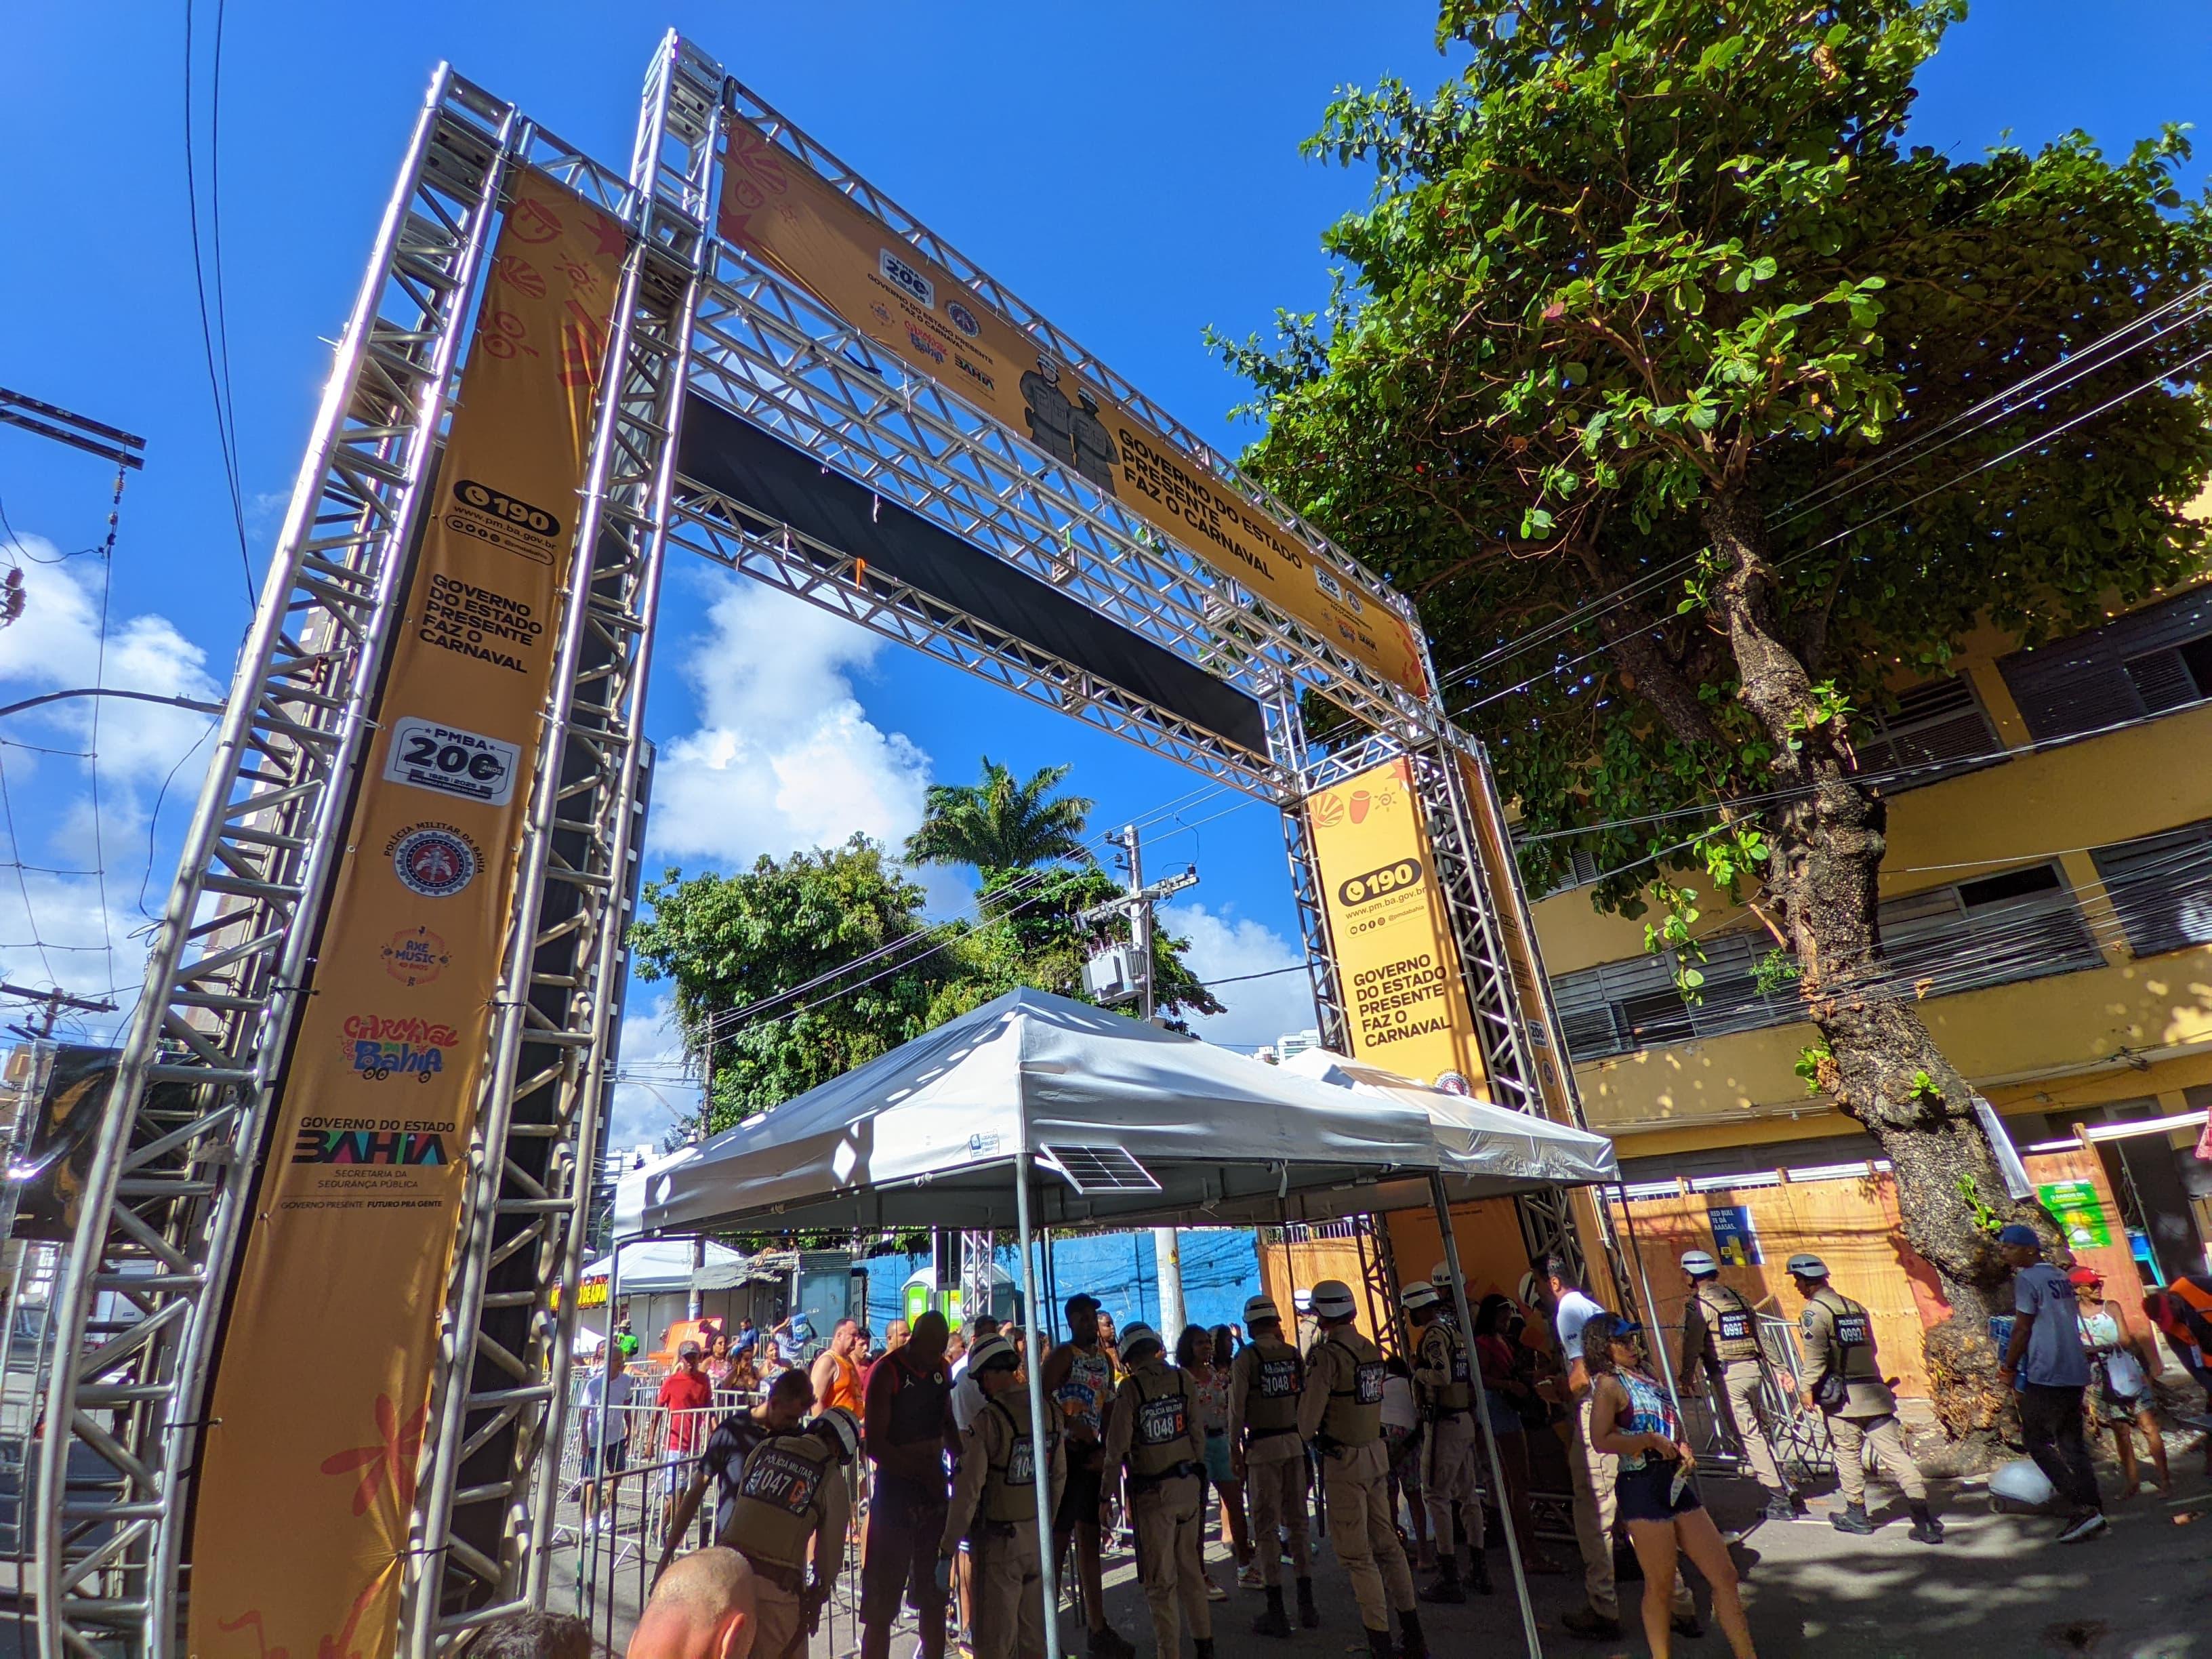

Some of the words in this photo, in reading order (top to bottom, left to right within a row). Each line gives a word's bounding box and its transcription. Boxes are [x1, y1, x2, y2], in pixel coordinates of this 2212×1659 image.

[867, 273, 908, 304] GOVERNO
[909, 302, 922, 314] DO
[923, 312, 954, 337] ESTADO
[955, 333, 994, 365] PRESENTE
[901, 303, 916, 318] FAZ
[925, 321, 966, 352] CARNAVAL
[1119, 428, 1210, 504] GOVERNO
[1214, 496, 1239, 524] DO
[1242, 515, 1302, 569] ESTADO
[1121, 445, 1221, 529] PRESENTE
[455, 506, 556, 549] www.pm.ba.gov.br
[493, 497, 550, 530] 190
[1124, 465, 1162, 504] FAZ
[1166, 495, 1180, 515] O
[1185, 508, 1275, 581] CARNAVAL
[430, 586, 460, 607] DO
[464, 599, 542, 634] ESTADO
[433, 573, 531, 617] GOVERNO
[423, 613, 463, 638] FAZ
[467, 630, 483, 643] O
[426, 600, 533, 647] PRESENTE
[419, 628, 527, 674] CARNAVAL
[434, 728, 488, 751] PMBA
[454, 779, 477, 788] 2025
[482, 765, 502, 774] ANOS
[384, 825, 414, 857] POLÍCIA
[416, 821, 460, 835] MILITAR
[462, 833, 474, 846] DA
[473, 846, 485, 874] BAHIA
[1366, 863, 1413, 895] 190
[1345, 886, 1427, 920] www.pm.ba.gov.br
[1388, 905, 1425, 922] @pmdabahia
[395, 949, 436, 964] MUSIC
[1353, 954, 1431, 986] GOVERNO
[1356, 985, 1379, 1002] DO
[1382, 965, 1447, 995] ESTADO
[1359, 983, 1444, 1017] PRESENTE
[1362, 1013, 1393, 1033] FAZ
[1395, 1010, 1407, 1023] O
[1365, 1016, 1452, 1048] CARNAVAL
[301, 1117, 375, 1130] GOVERNO
[379, 1120, 401, 1131] DO
[403, 1120, 456, 1132] ESTADO
[291, 1129, 449, 1165] BAHIA
[318, 1180, 377, 1189] SEGURANÇA
[380, 1179, 418, 1188] PÚBLICA
[333, 1170, 392, 1178] SECRETARIA
[281, 1200, 325, 1209] GOVERNO
[325, 1200, 364, 1209] PRESENTE
[367, 1200, 398, 1208] FUTURO
[1723, 1322, 1743, 1336] 0992
[1840, 1327, 1863, 1342] 0992
[1267, 1375, 1289, 1396] 1048
[1166, 1403, 1183, 1413] MILITAR
[1146, 1416, 1174, 1437] 1048
[754, 1467, 793, 1496] 1047
[789, 1461, 813, 1478] MILITAR
